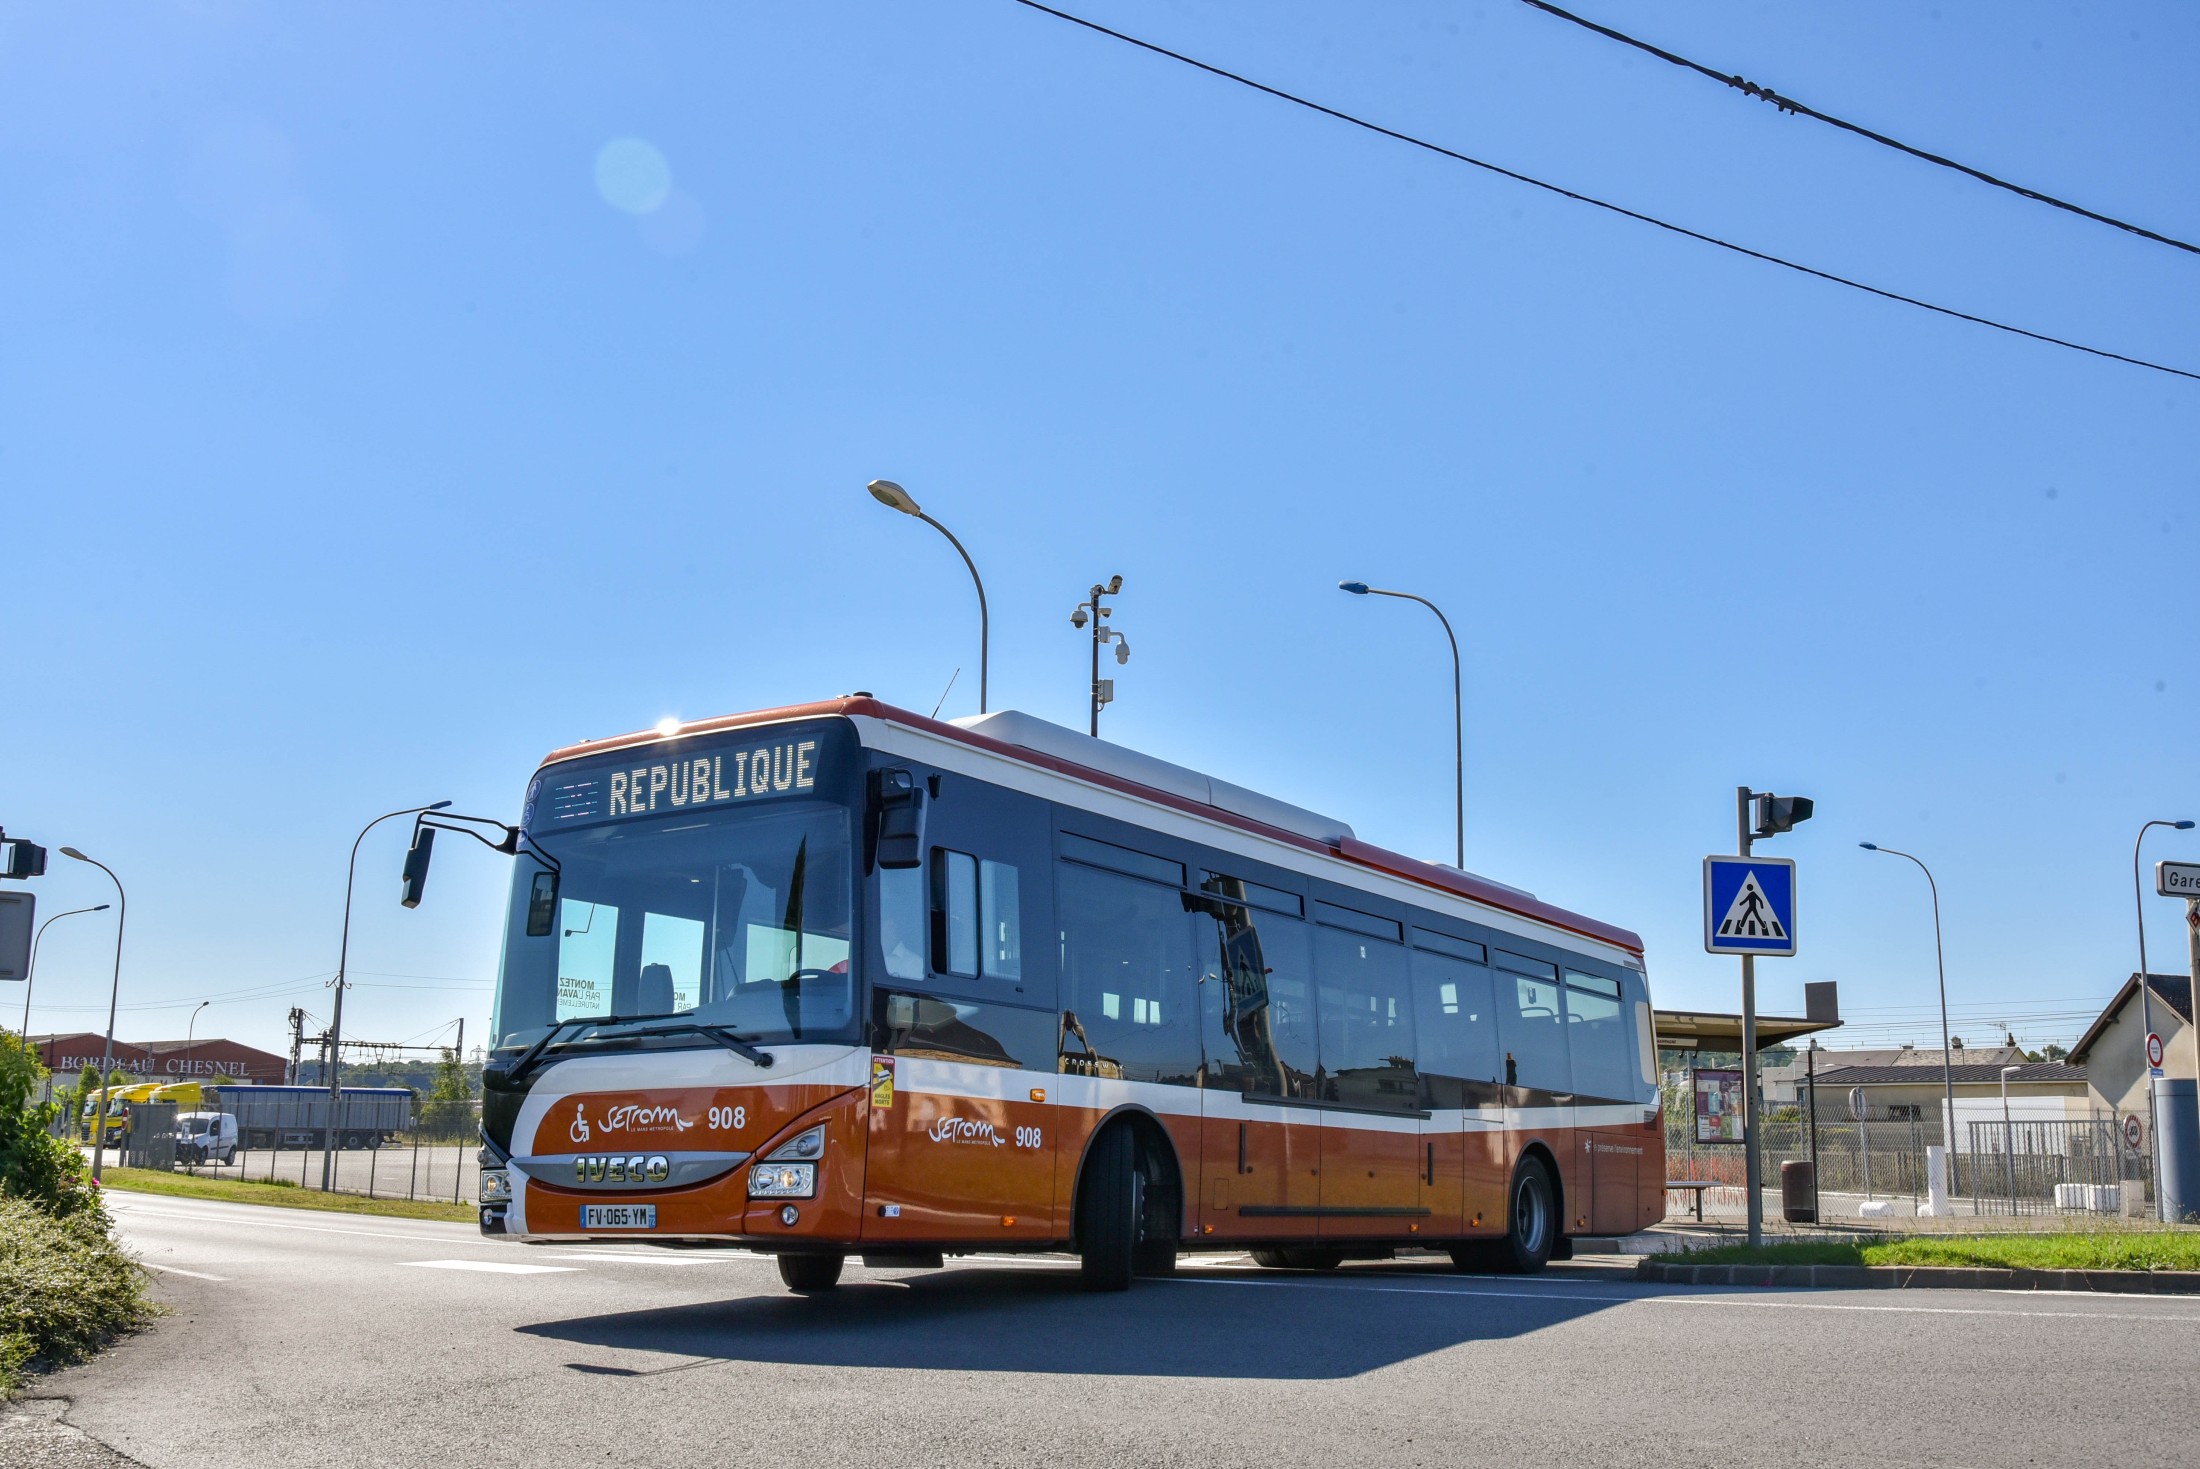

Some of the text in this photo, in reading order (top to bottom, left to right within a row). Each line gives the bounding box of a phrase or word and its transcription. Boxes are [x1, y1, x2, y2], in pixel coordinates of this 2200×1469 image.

[610, 741, 815, 816] REPUBLIQUE
[60, 1056, 250, 1076] BORDEAU CHESNEL
[1064, 1057, 1125, 1071] CROSSWAY
[708, 1106, 746, 1130] 908
[1015, 1125, 1042, 1149] 908
[576, 1155, 669, 1183] IVECO
